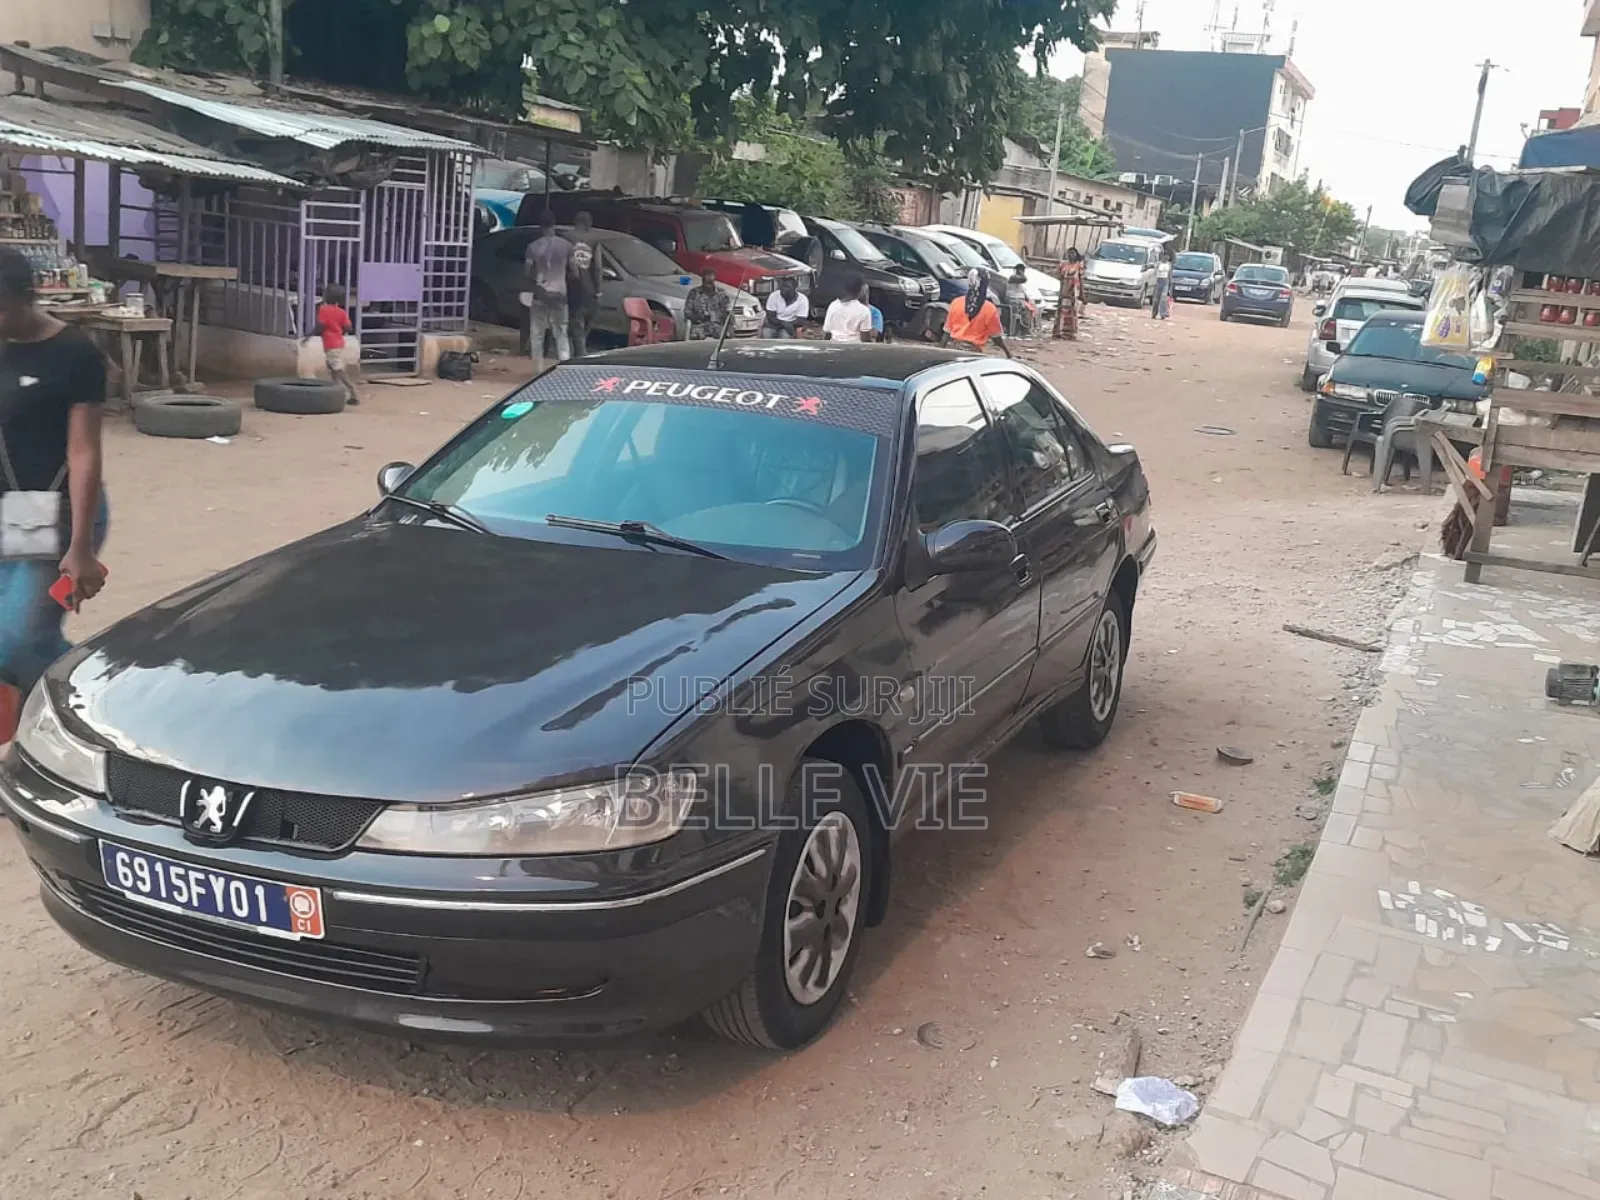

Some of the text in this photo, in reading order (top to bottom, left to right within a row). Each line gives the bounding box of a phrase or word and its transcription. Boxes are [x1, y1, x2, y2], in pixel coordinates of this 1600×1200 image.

[622, 379, 788, 409] PEUGEOT
[115, 851, 268, 922] 6915FY01
[296, 918, 311, 932] CI
